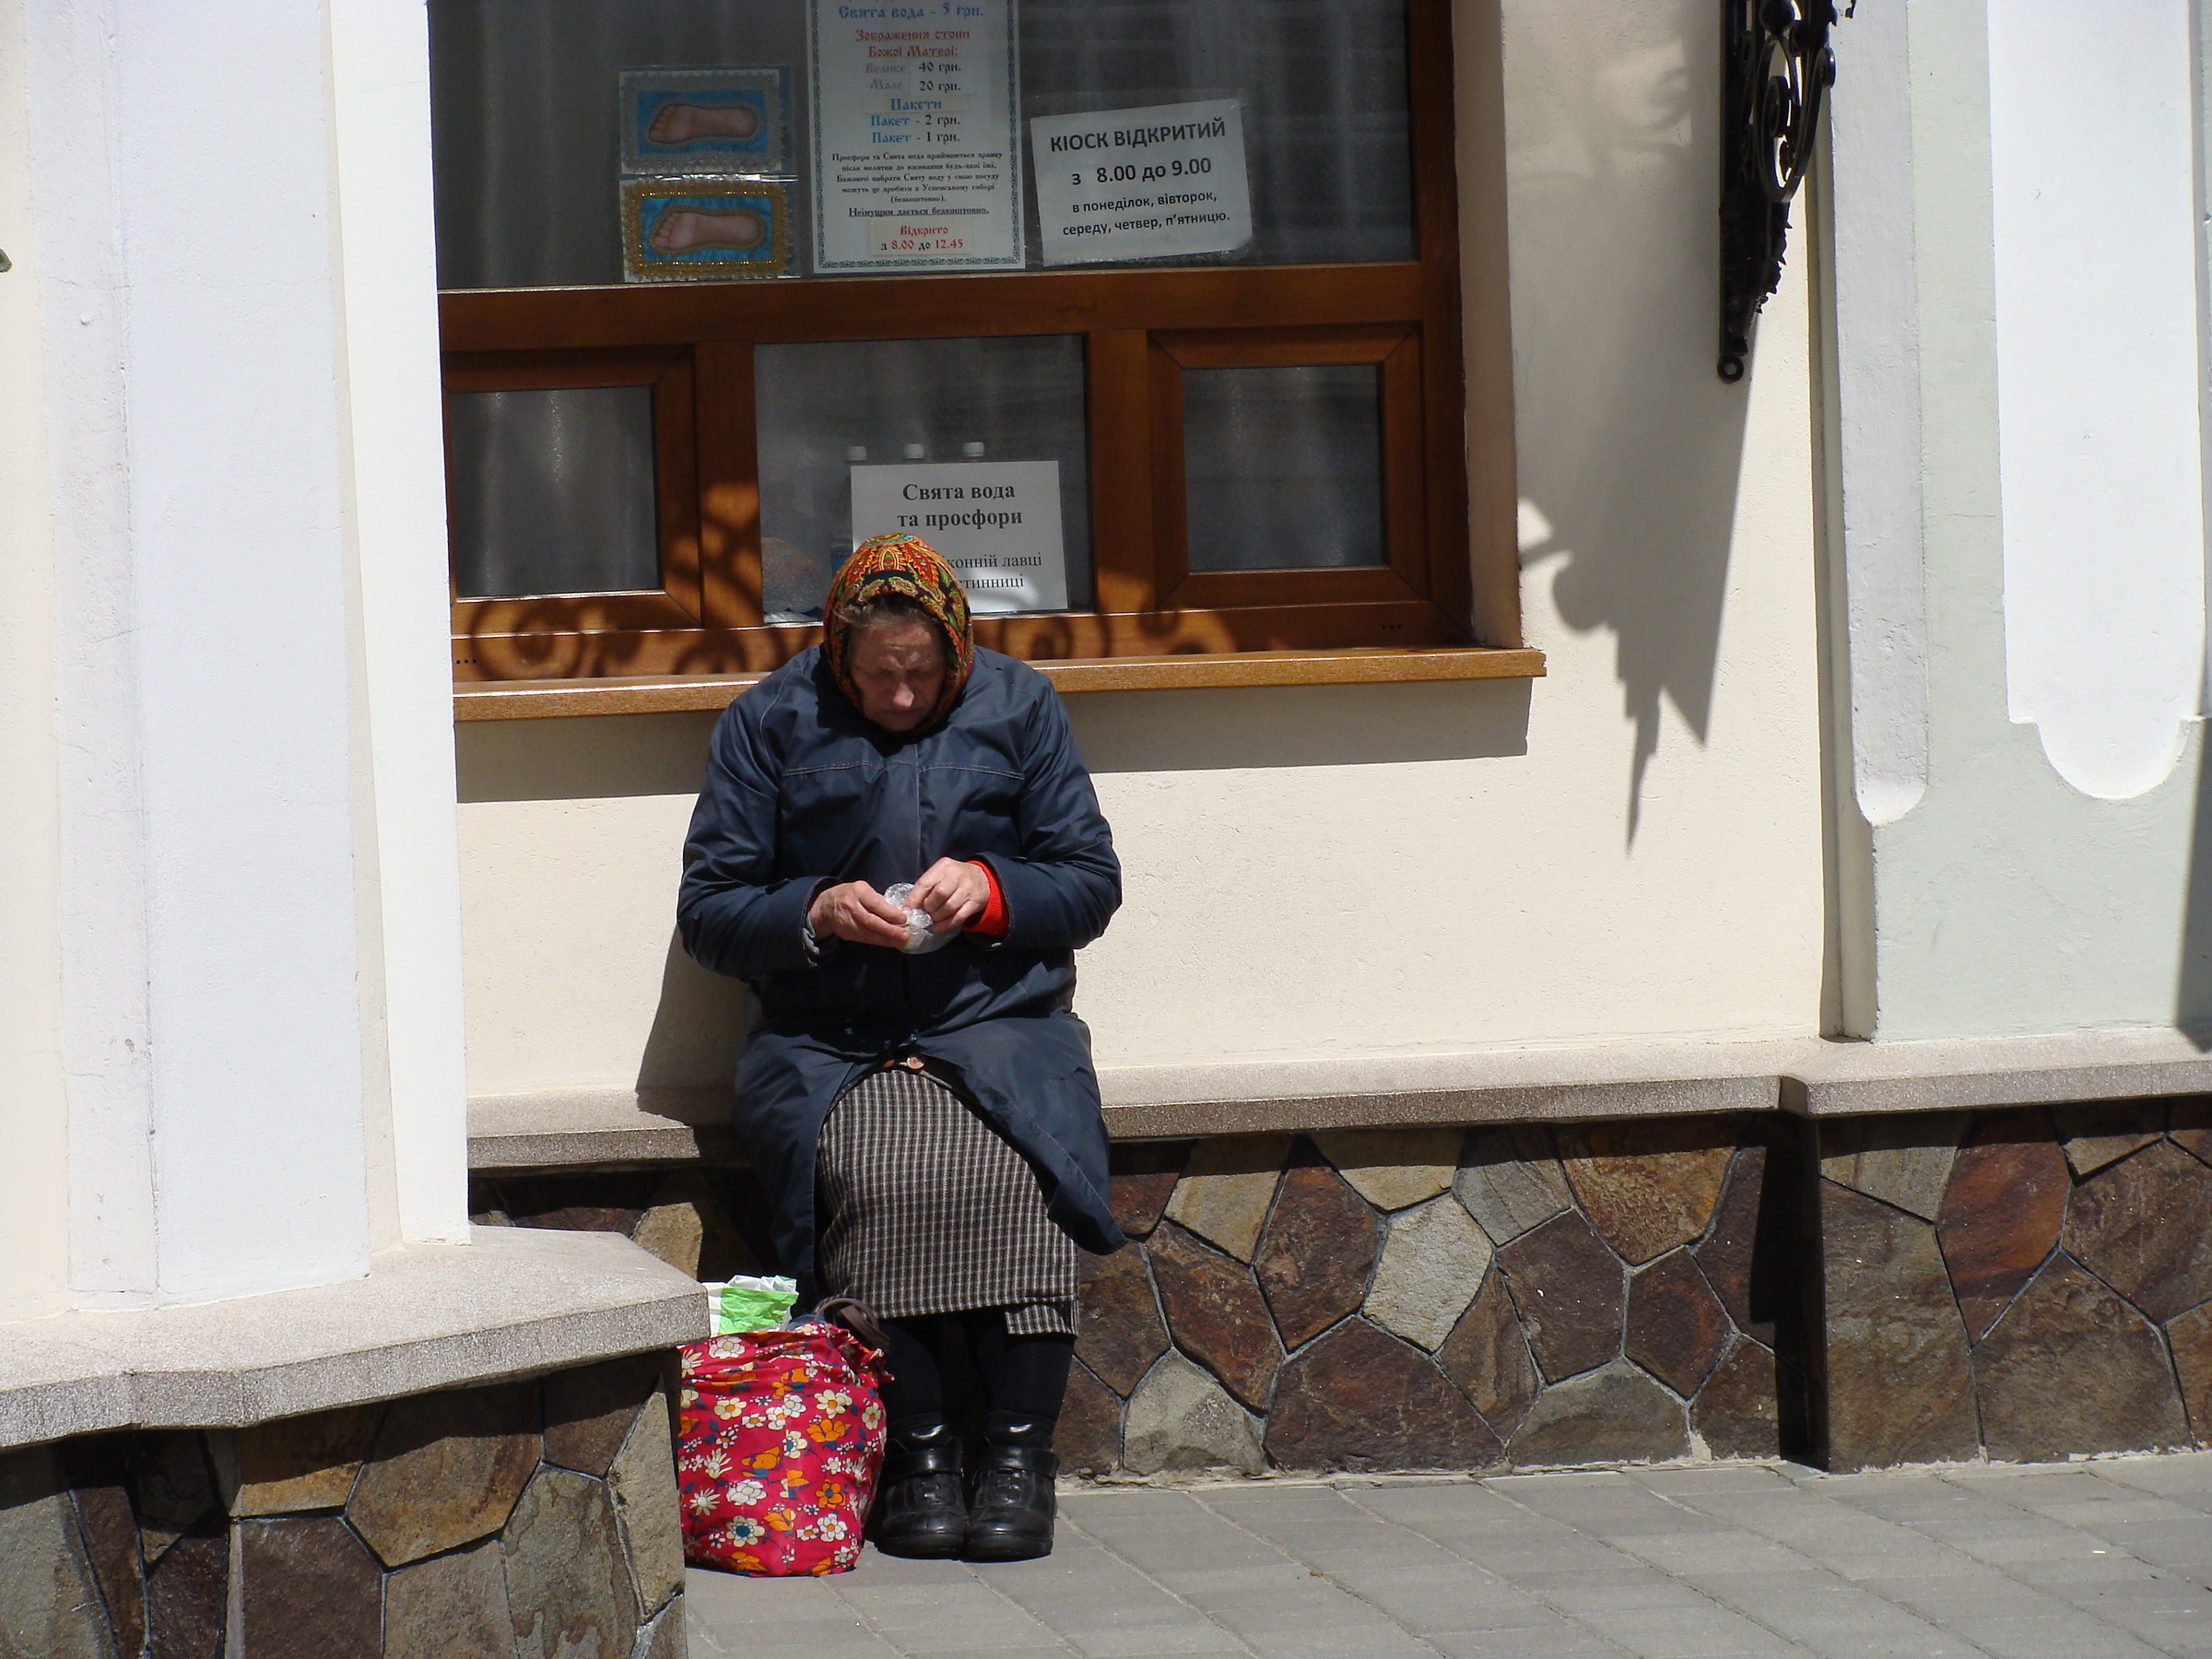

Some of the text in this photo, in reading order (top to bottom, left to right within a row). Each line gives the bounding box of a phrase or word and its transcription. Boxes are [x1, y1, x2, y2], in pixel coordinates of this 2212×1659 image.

[839, 5, 886, 18] Свята
[891, 7, 924, 20] вода
[942, 3, 950, 16] 5
[956, 6, 984, 18] грн.
[854, 29, 970, 42] Зображення стопи
[868, 45, 959, 58] Божої Матері:
[918, 61, 935, 72] 40
[938, 63, 961, 74] грн.
[870, 78, 961, 94] Мале 20 грн.
[890, 98, 943, 111] Пакети
[870, 114, 911, 126] Пакет
[924, 113, 932, 125] 2
[936, 116, 960, 127] грн.
[872, 132, 912, 143] Пакет
[926, 131, 931, 142] 1
[936, 134, 960, 144] грн.
[1051, 117, 1226, 152] КІОСК ВІДКРИТИЙ
[832, 153, 870, 162] Просфора
[883, 151, 905, 160] Свята
[836, 174, 869, 182] Бажаючі
[872, 174, 900, 182] набрати
[903, 173, 925, 182] Святу
[1071, 157, 1211, 185] з 8.00 до 9.00
[841, 187, 869, 195] можуть
[883, 185, 912, 194] зробити
[922, 184, 969, 193] Успенському
[971, 183, 995, 192] соборі
[1072, 191, 1218, 213] в понеділок, вівторок,
[848, 207, 894, 218] Неімущим
[900, 225, 948, 237] Відкрито
[1063, 222, 1112, 237] середу,
[1114, 218, 1162, 231] четвер,
[891, 239, 914, 250] 8.00
[918, 242, 931, 251] до
[935, 238, 964, 249] 12.45
[902, 483, 1016, 500] Свята вода
[897, 509, 1023, 531] та просфори
[944, 552, 1042, 570] конній лавці
[957, 573, 1025, 590] тинниці
